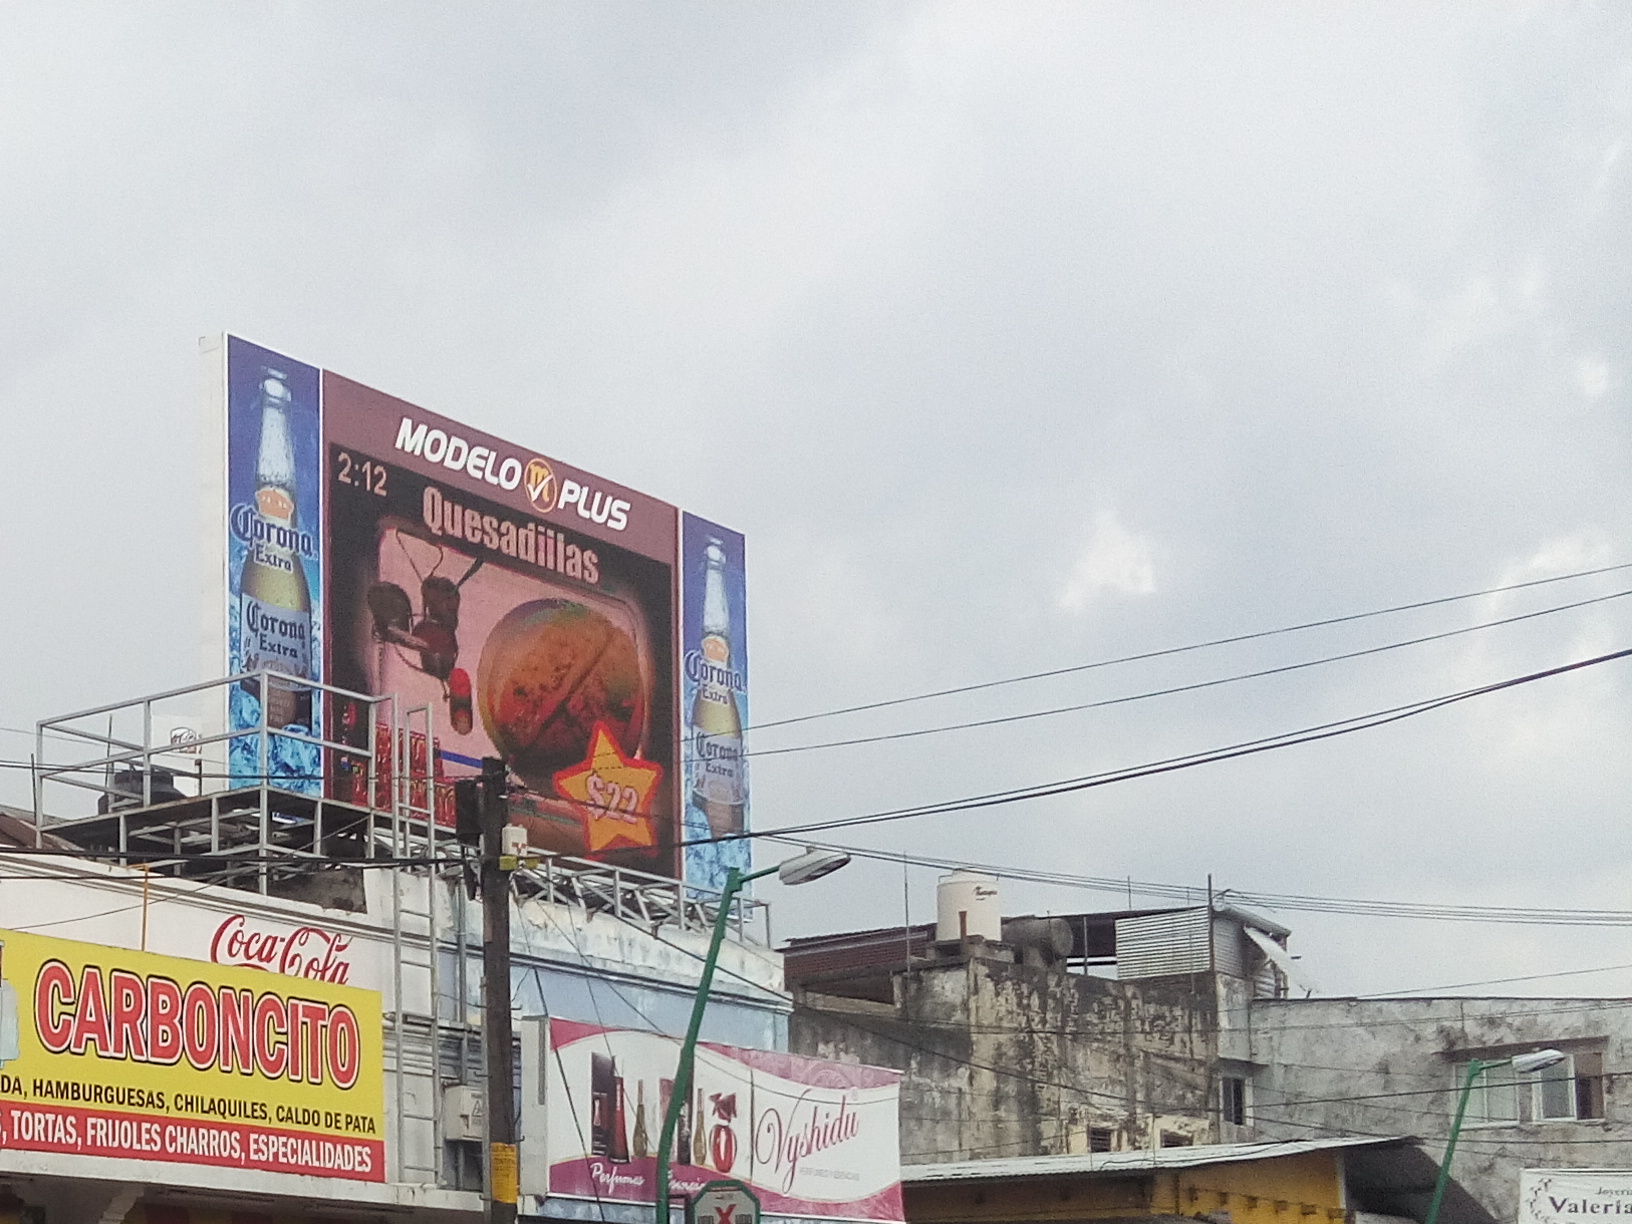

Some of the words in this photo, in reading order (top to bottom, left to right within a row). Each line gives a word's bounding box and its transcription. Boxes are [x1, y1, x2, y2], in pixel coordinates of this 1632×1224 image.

[337, 451, 388, 497] 2:12
[395, 417, 522, 490] MODELO
[558, 479, 631, 531] PLUS
[230, 502, 314, 559] Corona
[254, 541, 293, 573] Extra
[423, 486, 599, 584] Quesadillas
[246, 600, 306, 642] Corona
[259, 632, 298, 659] Extra
[685, 650, 744, 693] Corona
[586, 769, 638, 824] $22
[211, 914, 352, 985] Coca-Cola
[34, 958, 361, 1090] CARBONCITO
[32, 1079, 170, 1114] HAMBURGUESAS,
[174, 1093, 273, 1125] CHILAQUILES,
[276, 1105, 320, 1129] CALDO
[324, 1111, 343, 1130] DE
[345, 1114, 376, 1135] PATA
[10, 1111, 82, 1151] TORTAS,
[86, 1117, 162, 1153] FRIJOLES
[165, 1124, 246, 1166] CHARROS,
[249, 1133, 373, 1173] ESPECIALIDADES
[755, 1088, 860, 1194] Vyshidu
[590, 1162, 645, 1195] Perfumes
[1549, 1196, 1632, 1214] Valeria
